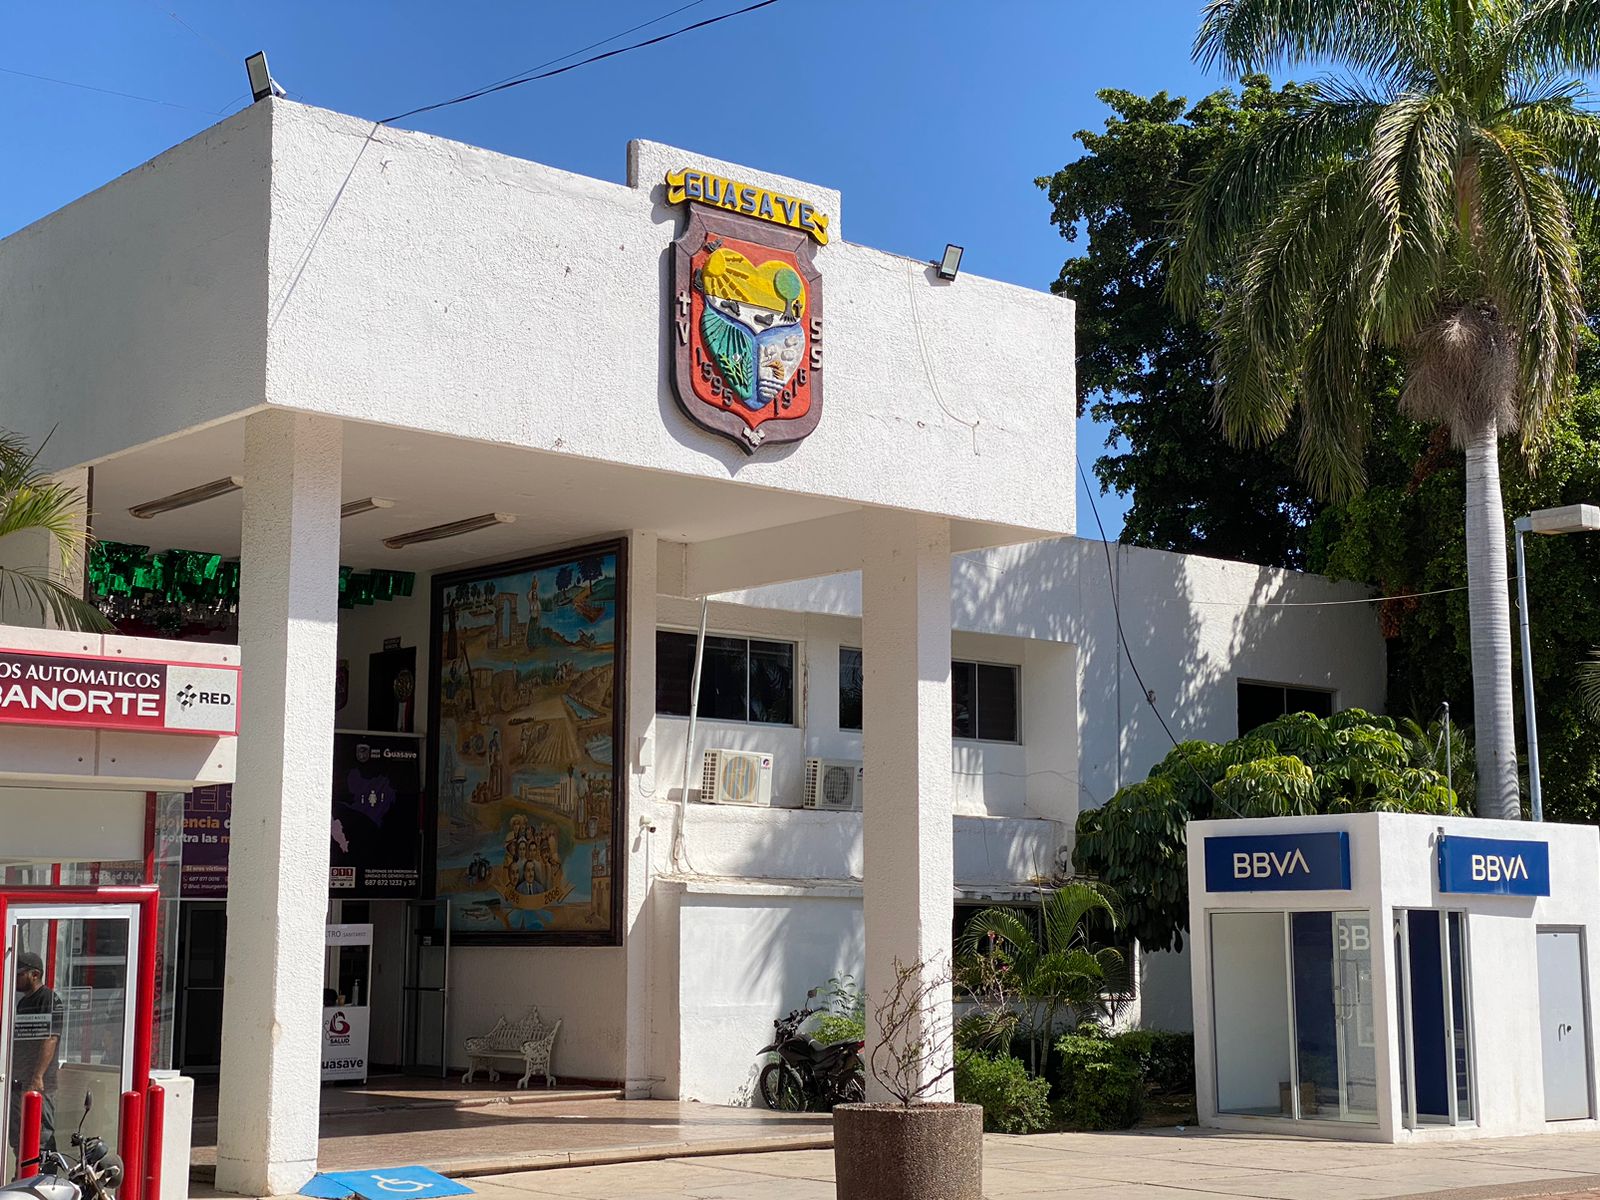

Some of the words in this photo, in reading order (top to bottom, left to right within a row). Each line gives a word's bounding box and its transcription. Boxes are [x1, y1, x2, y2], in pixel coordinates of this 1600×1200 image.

[684, 172, 815, 229] GUASAVE
[25, 664, 160, 689] AUTOMATICOS
[0, 684, 160, 717] ANORTE
[199, 692, 231, 705] RED
[201, 833, 217, 843] las
[1233, 848, 1310, 879] BBVA
[1471, 854, 1529, 882] BBVA
